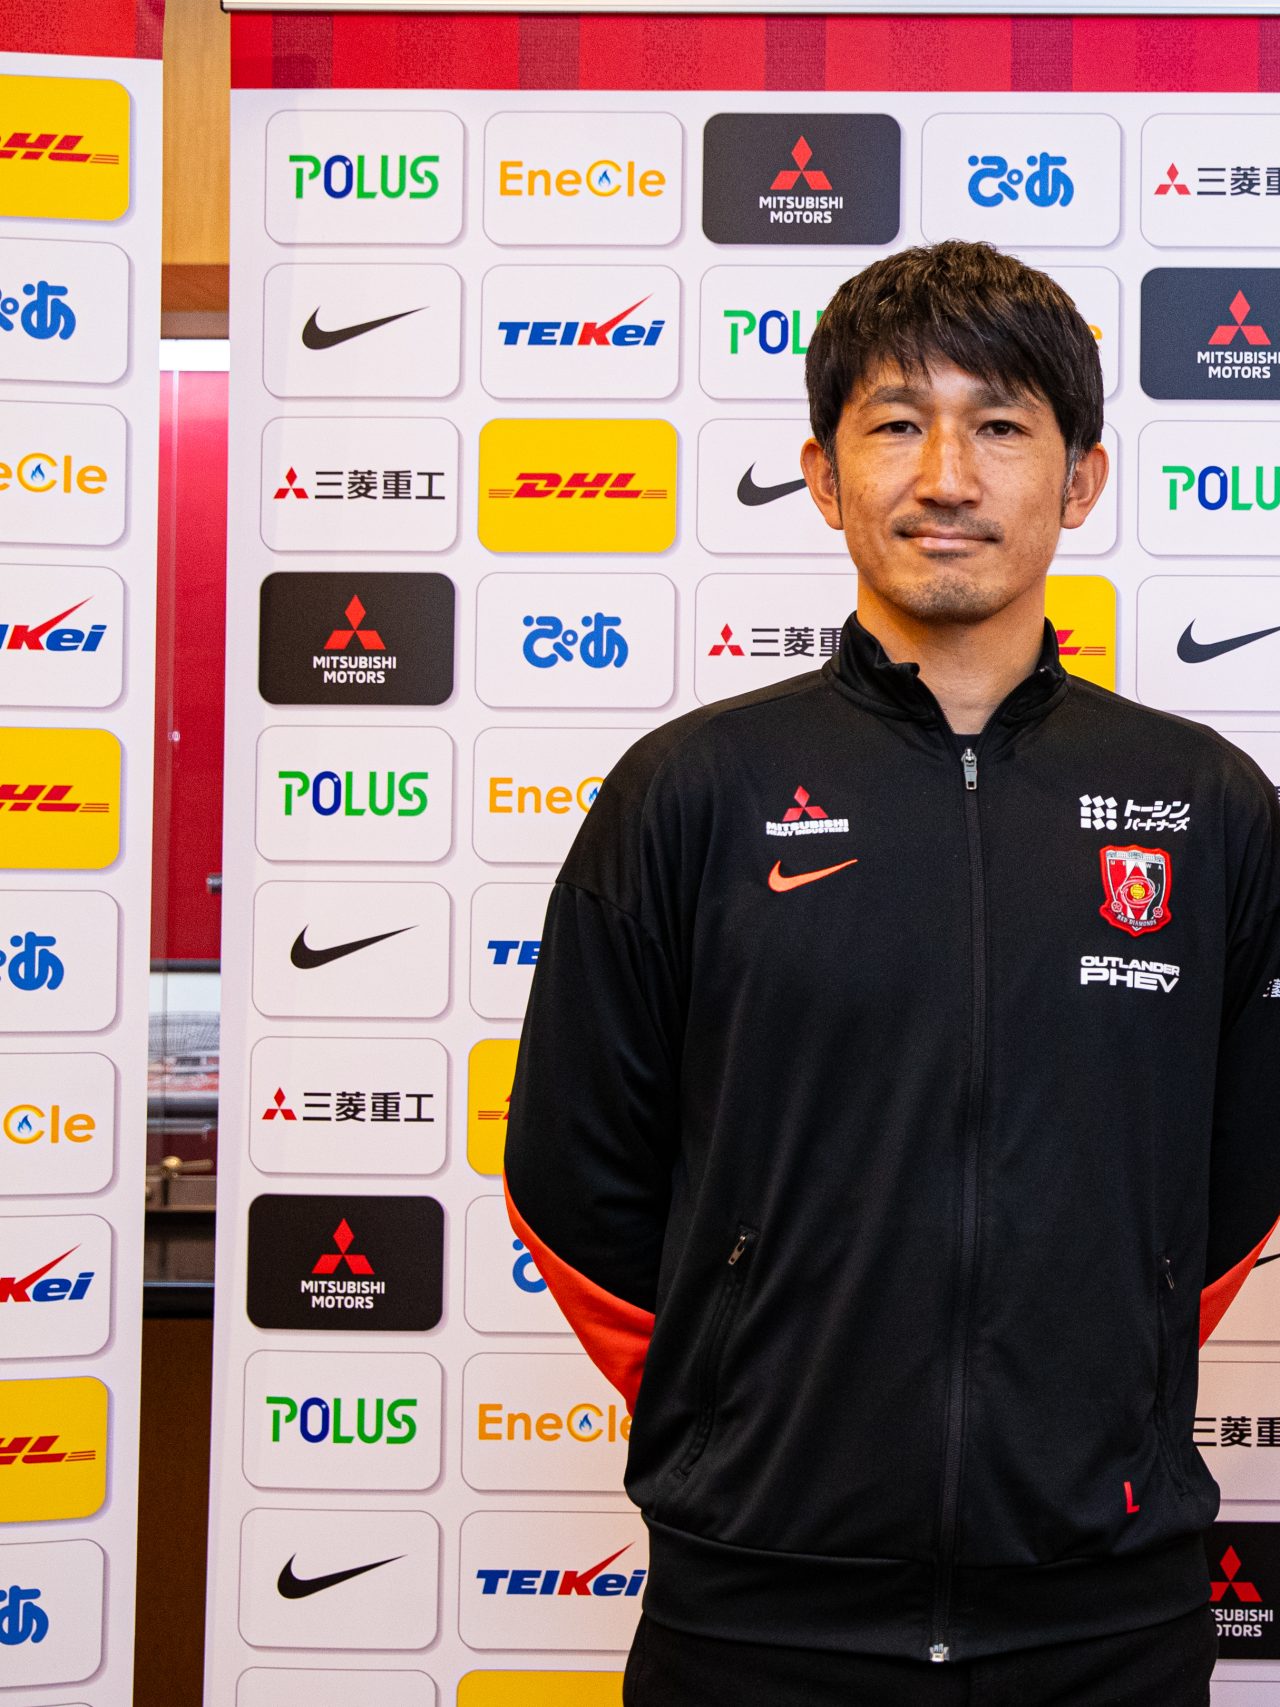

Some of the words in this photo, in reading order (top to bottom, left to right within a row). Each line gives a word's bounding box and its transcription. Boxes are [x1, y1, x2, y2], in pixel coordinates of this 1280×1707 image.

[0, 132, 91, 163] HL
[288, 154, 440, 200] POLUS
[498, 159, 667, 198] EneCle
[758, 195, 844, 210] MITSUBISHI
[769, 210, 833, 224] MOTORS
[0, 280, 77, 341] あ
[497, 300, 666, 347] TEIKei
[723, 309, 823, 355] POL
[1207, 365, 1271, 379] MOTORS
[0, 451, 108, 495] Cle
[314, 469, 445, 500] 三菱重工
[513, 472, 642, 499] DHL
[0, 600, 107, 652] Kei
[750, 626, 843, 658] 三菱重
[312, 655, 397, 670] MITSUBISHI
[323, 670, 386, 684] MOTORS
[0, 784, 81, 813] HL
[278, 770, 429, 817] POLUS
[1124, 799, 1190, 819] トーシン
[766, 819, 849, 832] MITSUBISHI
[1124, 817, 1190, 832] パートナーズ
[0, 931, 65, 991] あ
[1080, 955, 1180, 977] OUTLANDER
[1080, 967, 1180, 993] PHEV
[302, 1091, 435, 1123] 三菱重工
[2, 1103, 97, 1145] Cle
[0, 1247, 95, 1304] Kei
[300, 1280, 386, 1294] MITSUBISHI
[311, 1295, 374, 1309] MOTORS
[265, 1396, 417, 1445] POLUS
[476, 1543, 647, 1597] TEIKei
[1210, 1607, 1274, 1623] SUBISHI
